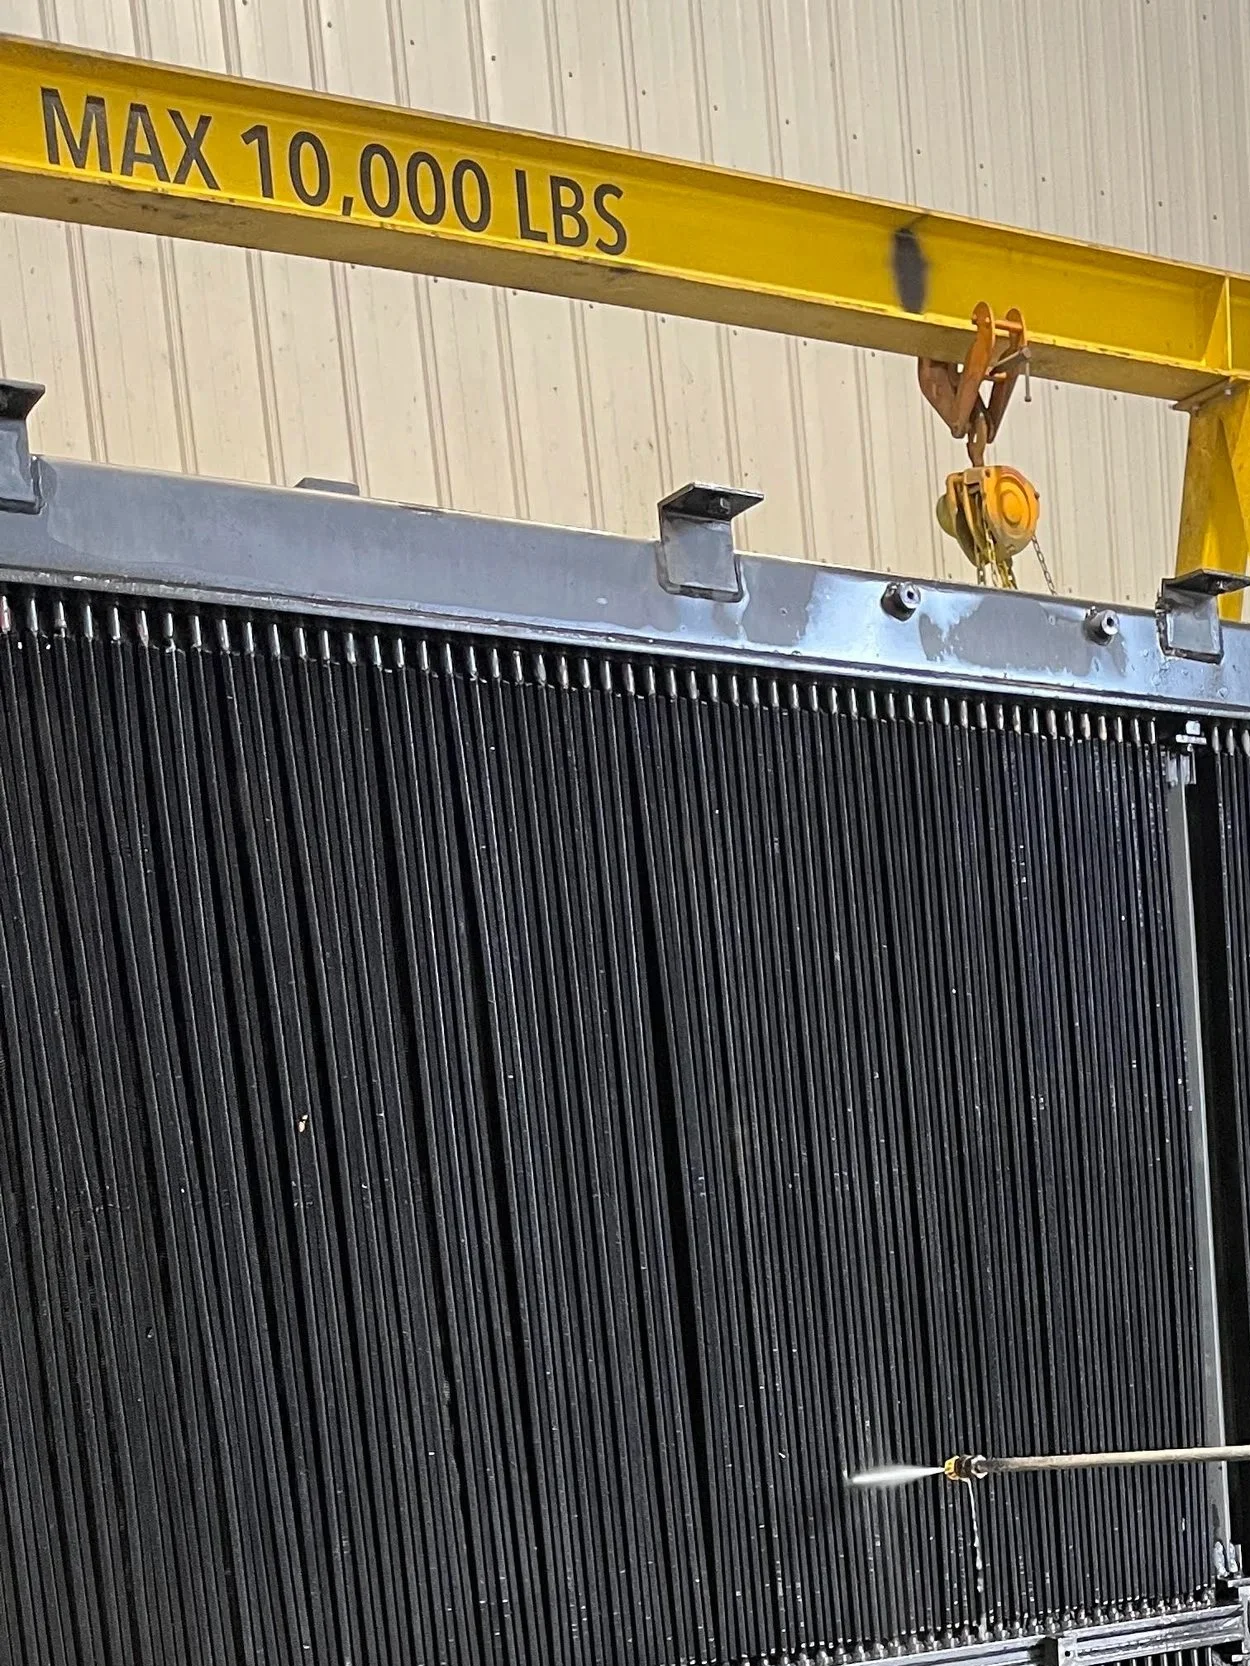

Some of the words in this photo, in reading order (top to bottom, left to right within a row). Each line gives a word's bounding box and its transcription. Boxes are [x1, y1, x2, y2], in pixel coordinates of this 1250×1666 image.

[41, 86, 220, 190] MAX
[241, 124, 491, 232] 10,000
[516, 168, 627, 255] LBS
